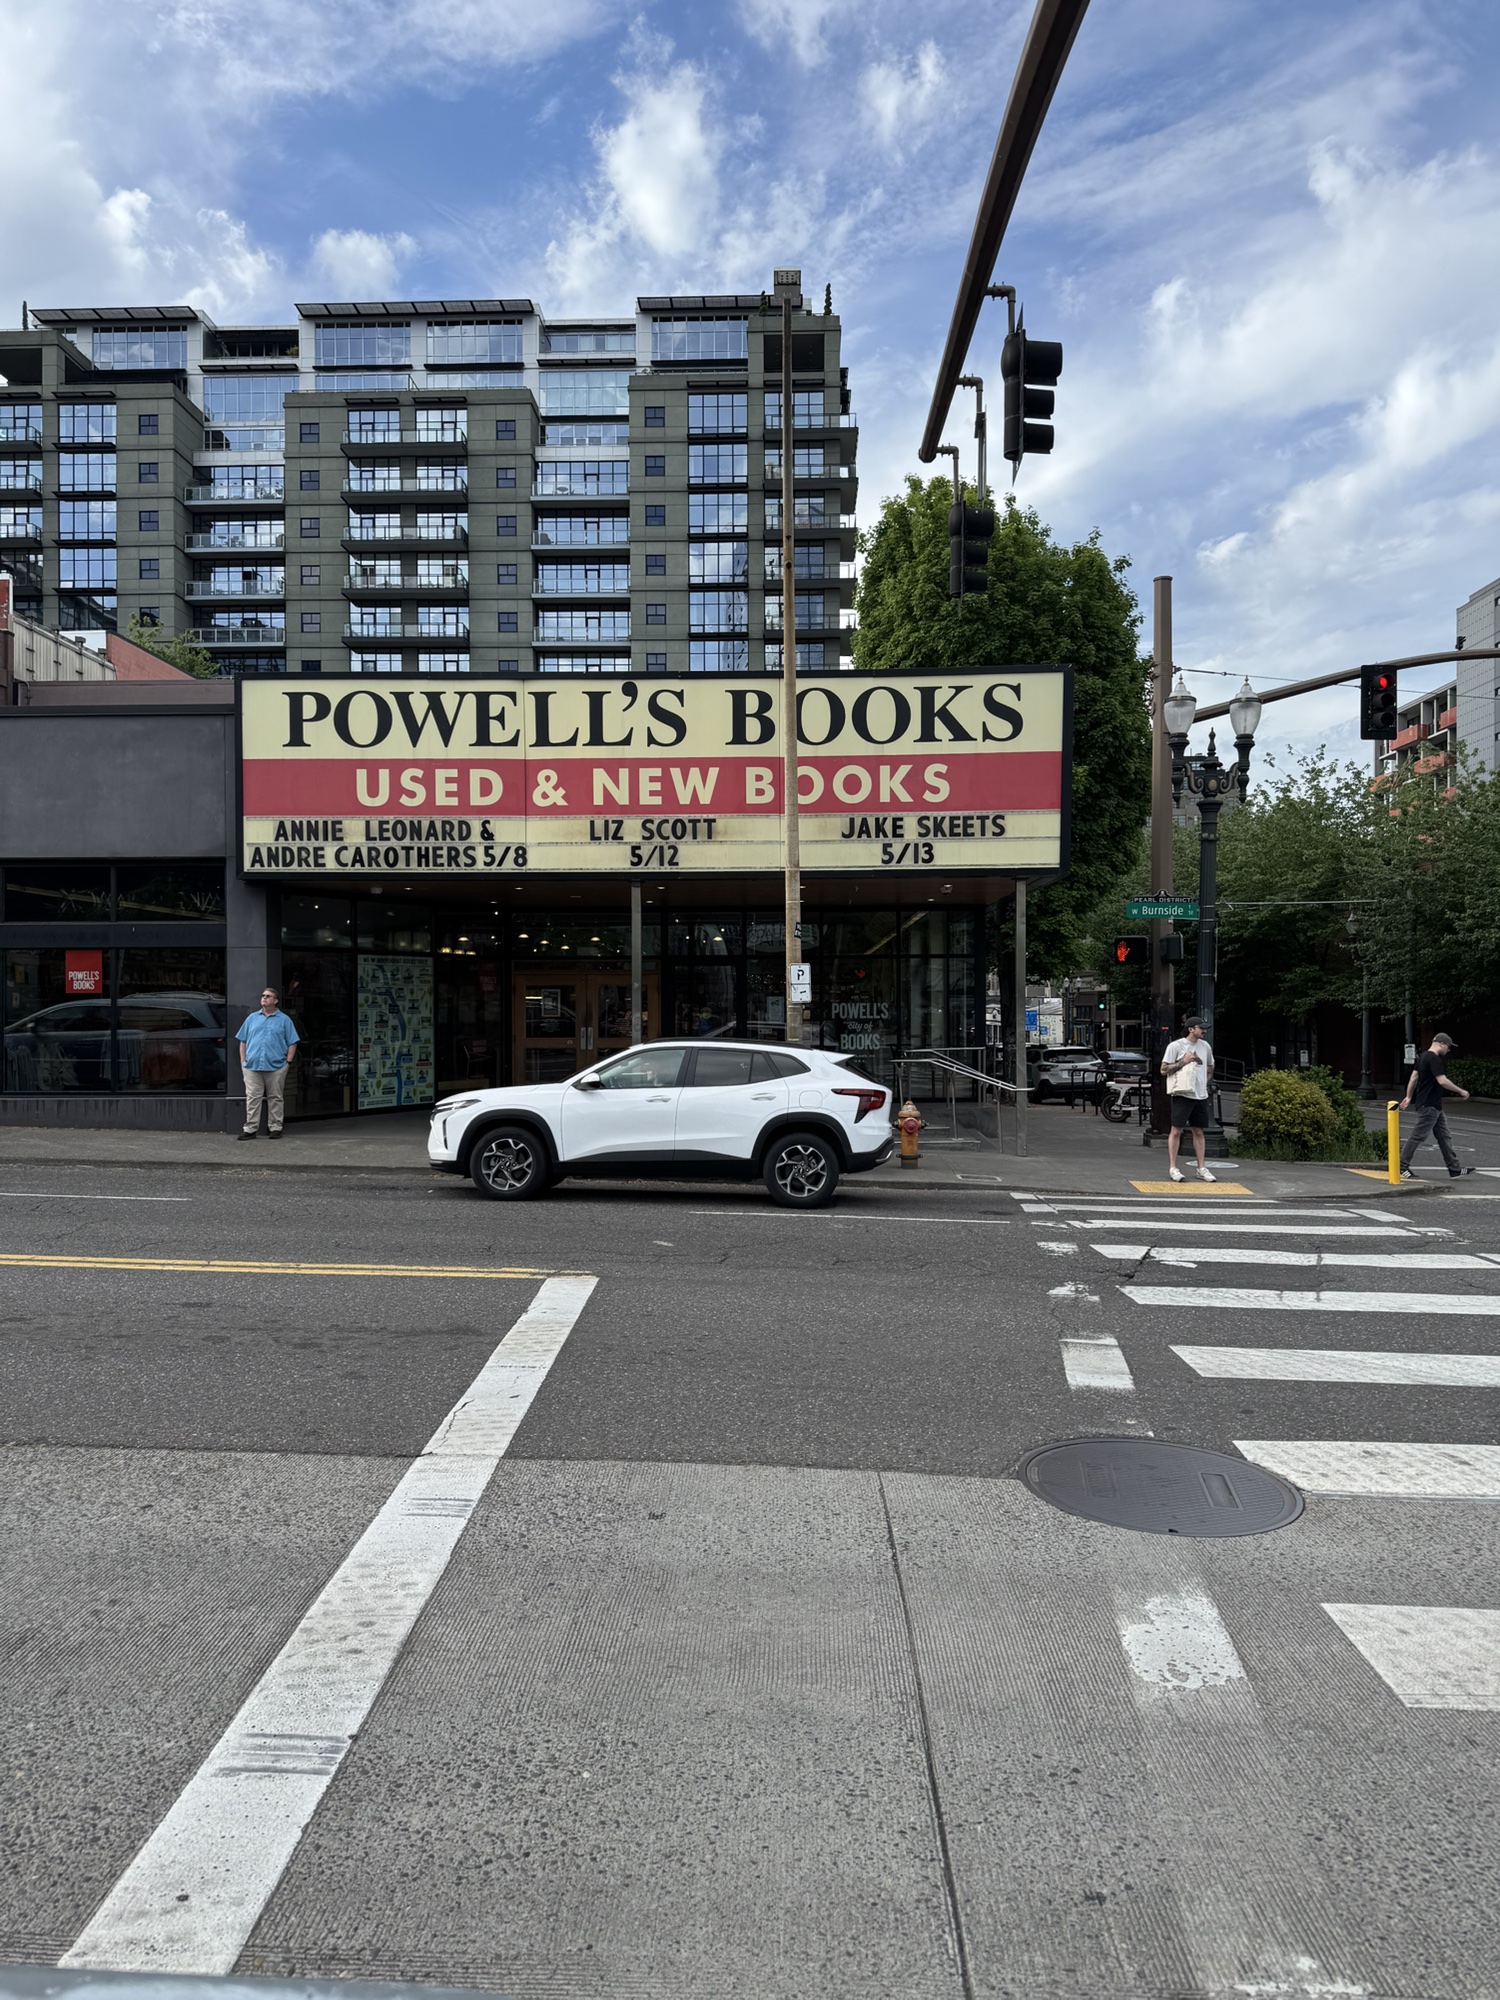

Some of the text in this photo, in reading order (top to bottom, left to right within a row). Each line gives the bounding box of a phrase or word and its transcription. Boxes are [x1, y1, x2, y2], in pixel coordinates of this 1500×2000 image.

[281, 681, 1024, 748] POWELL'S BOOKS
[355, 763, 951, 807] USED & NEW BOOKS
[274, 819, 495, 842] ANNIE LEONARD &
[589, 818, 717, 842] LIZ SCOTT
[841, 815, 1006, 839] JAKE SKEETS
[250, 846, 528, 868] ANDRE CAROTHERS 5/8
[629, 845, 680, 867] 5/12
[881, 842, 935, 865] 5/13
[1142, 905, 1184, 915] Burnside
[68, 971, 100, 980] POWELL'S
[73, 981, 95, 990] BOOKS
[831, 1002, 889, 1019] POWELL'S
[847, 1021, 874, 1032] city of
[840, 1033, 881, 1050] BOOKS
